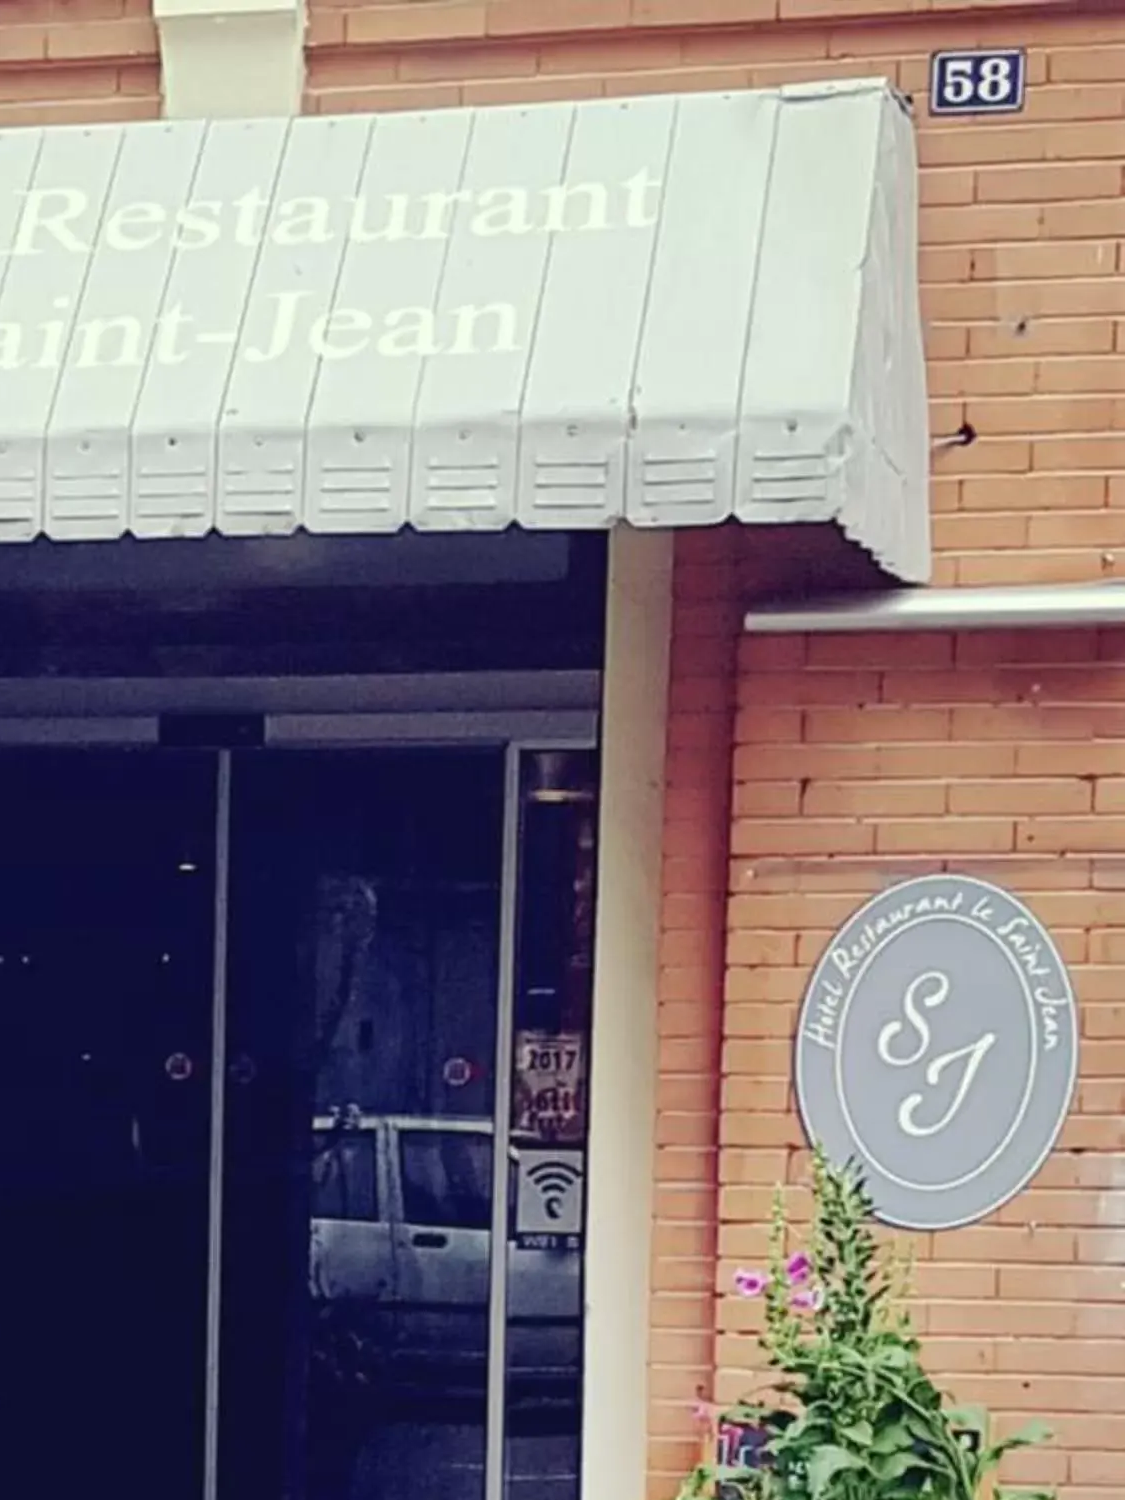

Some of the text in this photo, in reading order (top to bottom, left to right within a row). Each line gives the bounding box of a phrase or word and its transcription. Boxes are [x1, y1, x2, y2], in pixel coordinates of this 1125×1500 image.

[943, 58, 1012, 104] 58
[832, 892, 963, 979] Restaurant
[996, 917, 1051, 977] Saint
[1035, 987, 1069, 1050] Jean
[528, 1049, 577, 1071] 2017
